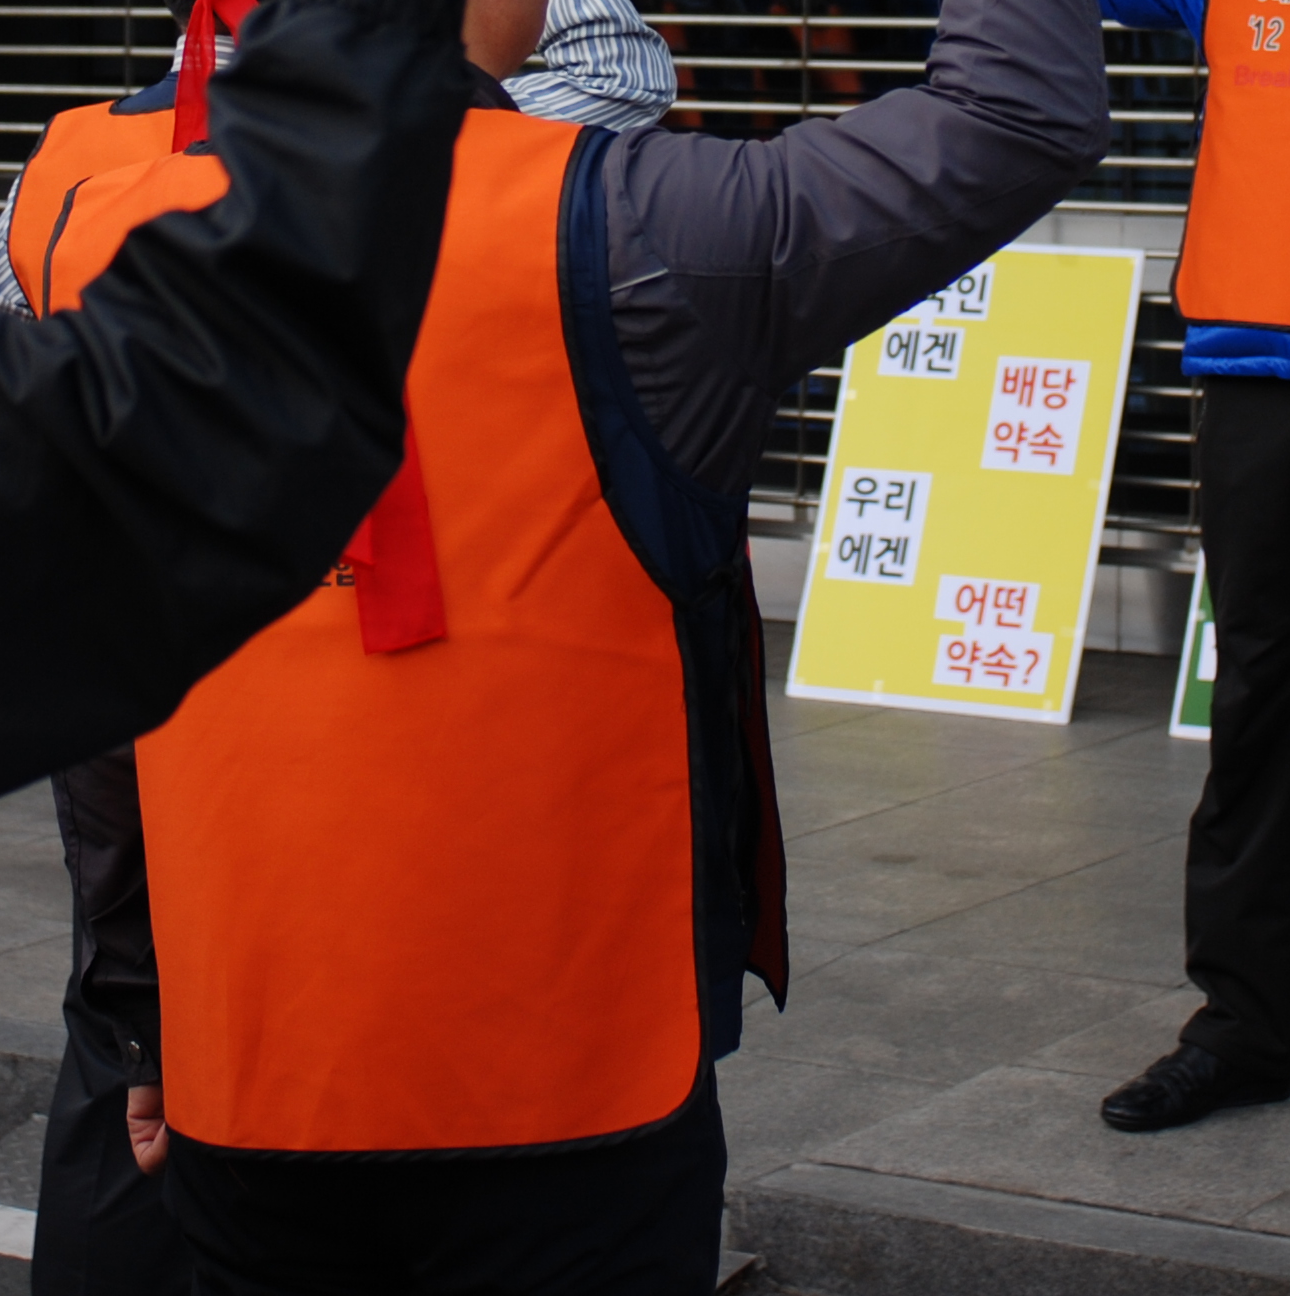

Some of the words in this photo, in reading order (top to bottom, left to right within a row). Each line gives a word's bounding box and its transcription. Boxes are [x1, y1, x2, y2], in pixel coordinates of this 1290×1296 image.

[885, 327, 958, 375] 에겐
[1001, 364, 1078, 411] 배당
[992, 421, 1065, 467] 약속
[844, 475, 918, 523] 우리
[837, 532, 911, 579] 에겐
[953, 582, 1029, 630] 어떤
[945, 639, 1041, 689] 약속?
